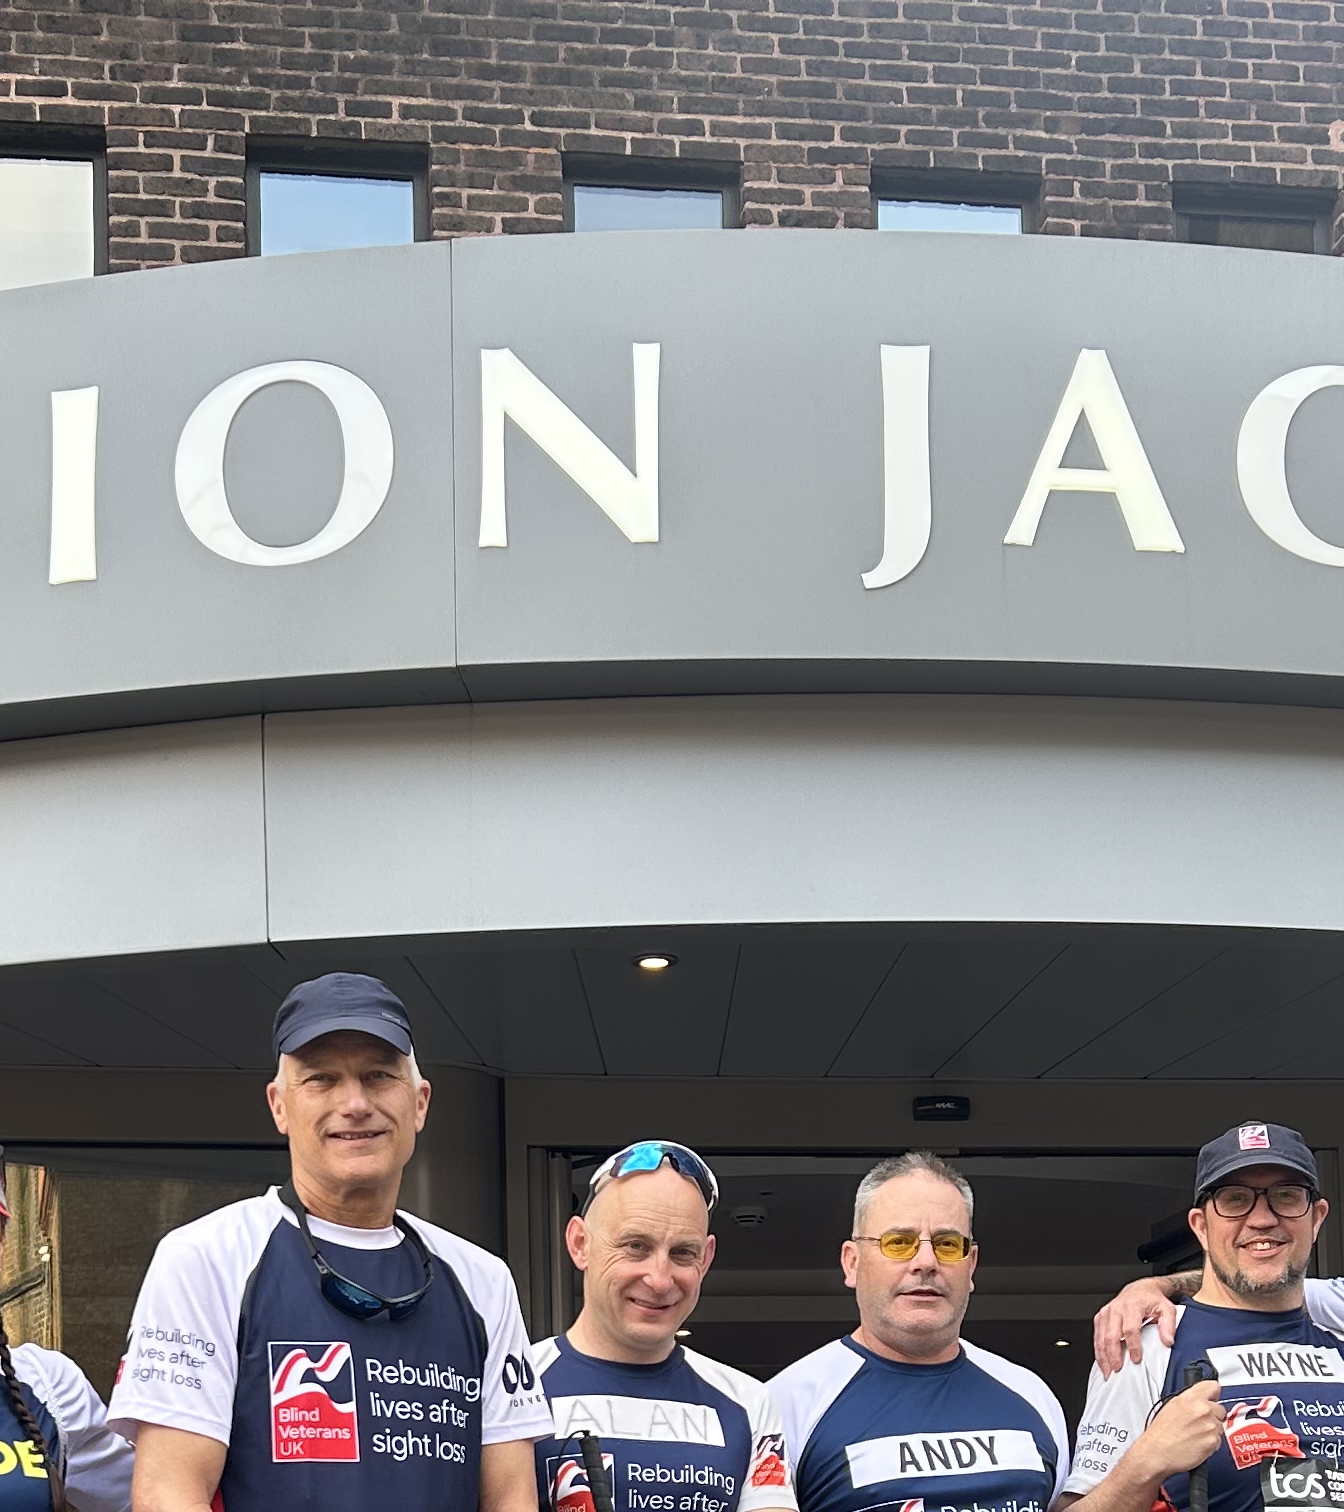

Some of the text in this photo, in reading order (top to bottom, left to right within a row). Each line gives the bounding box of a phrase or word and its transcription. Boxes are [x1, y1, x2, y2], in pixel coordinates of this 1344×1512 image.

[169, 1350, 206, 1369] after
[1237, 1352, 1335, 1377] WAYNE
[171, 1370, 201, 1389] loss
[366, 1359, 481, 1402] Rebuilding
[279, 1408, 319, 1422] Blind
[370, 1392, 469, 1428] lives after
[563, 1399, 708, 1442] ALAN
[279, 1426, 351, 1440] Veterans
[1234, 1431, 1268, 1444] Blind
[280, 1442, 304, 1456] UK
[372, 1428, 465, 1464] sight loss
[899, 1436, 998, 1473] ANDY
[1235, 1440, 1294, 1453] Veterans
[628, 1463, 735, 1496] Rebuilding
[1269, 1466, 1326, 1499] tcs
[628, 1488, 674, 1510] lives
